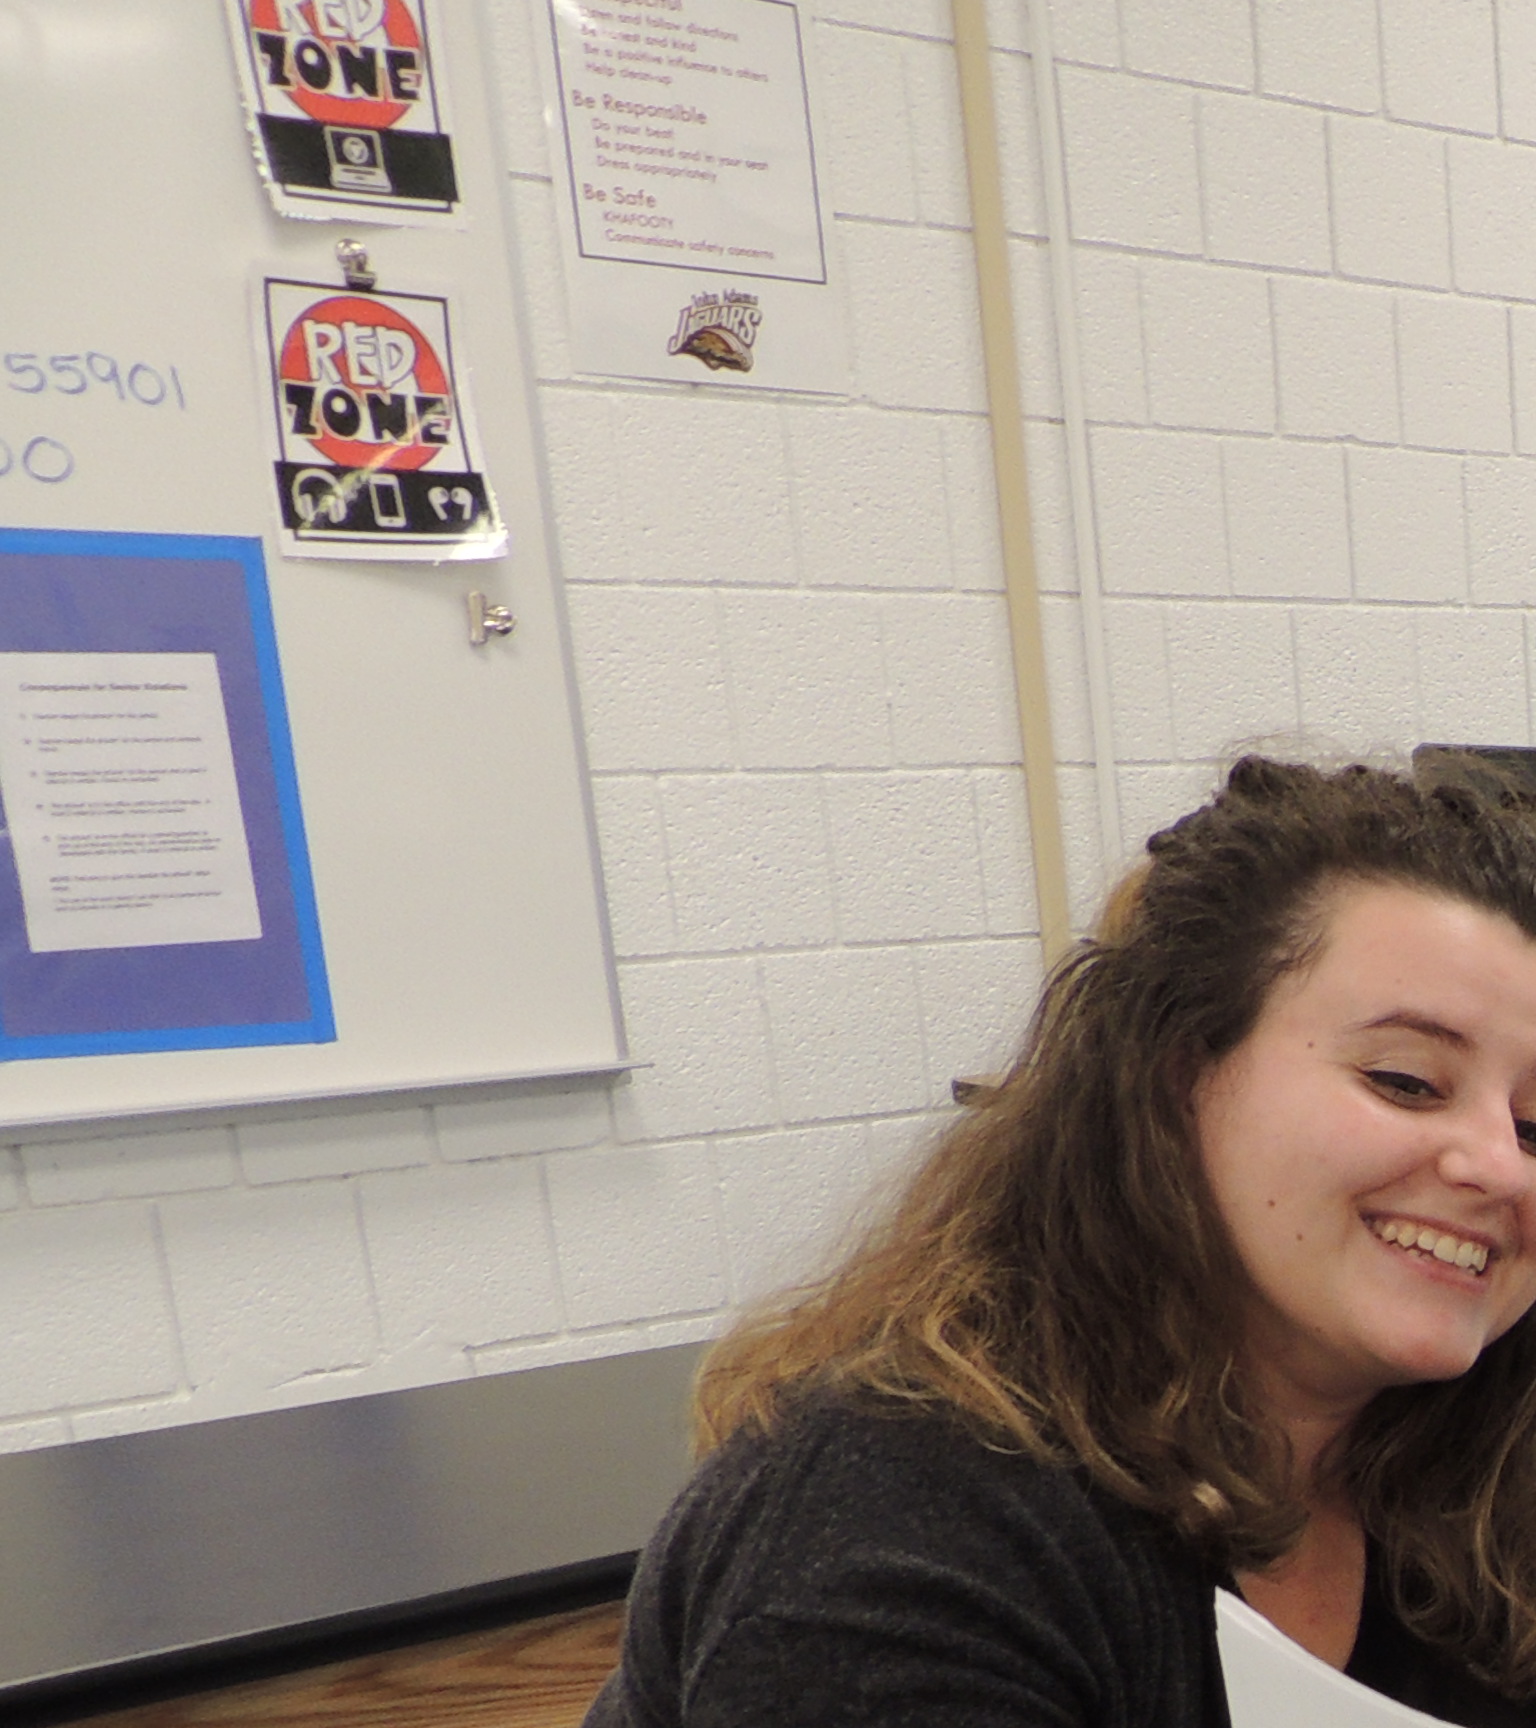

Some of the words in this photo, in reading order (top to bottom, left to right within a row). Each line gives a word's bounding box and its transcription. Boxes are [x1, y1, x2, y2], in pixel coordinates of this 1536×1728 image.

[256, 31, 421, 101] ZONE
[572, 88, 596, 109] Be
[602, 92, 707, 125] Responsible
[583, 182, 608, 203] Be
[612, 185, 658, 208] Safe
[3, 351, 188, 412] 55901
[302, 318, 418, 389] RED
[283, 381, 451, 445] ZONE
